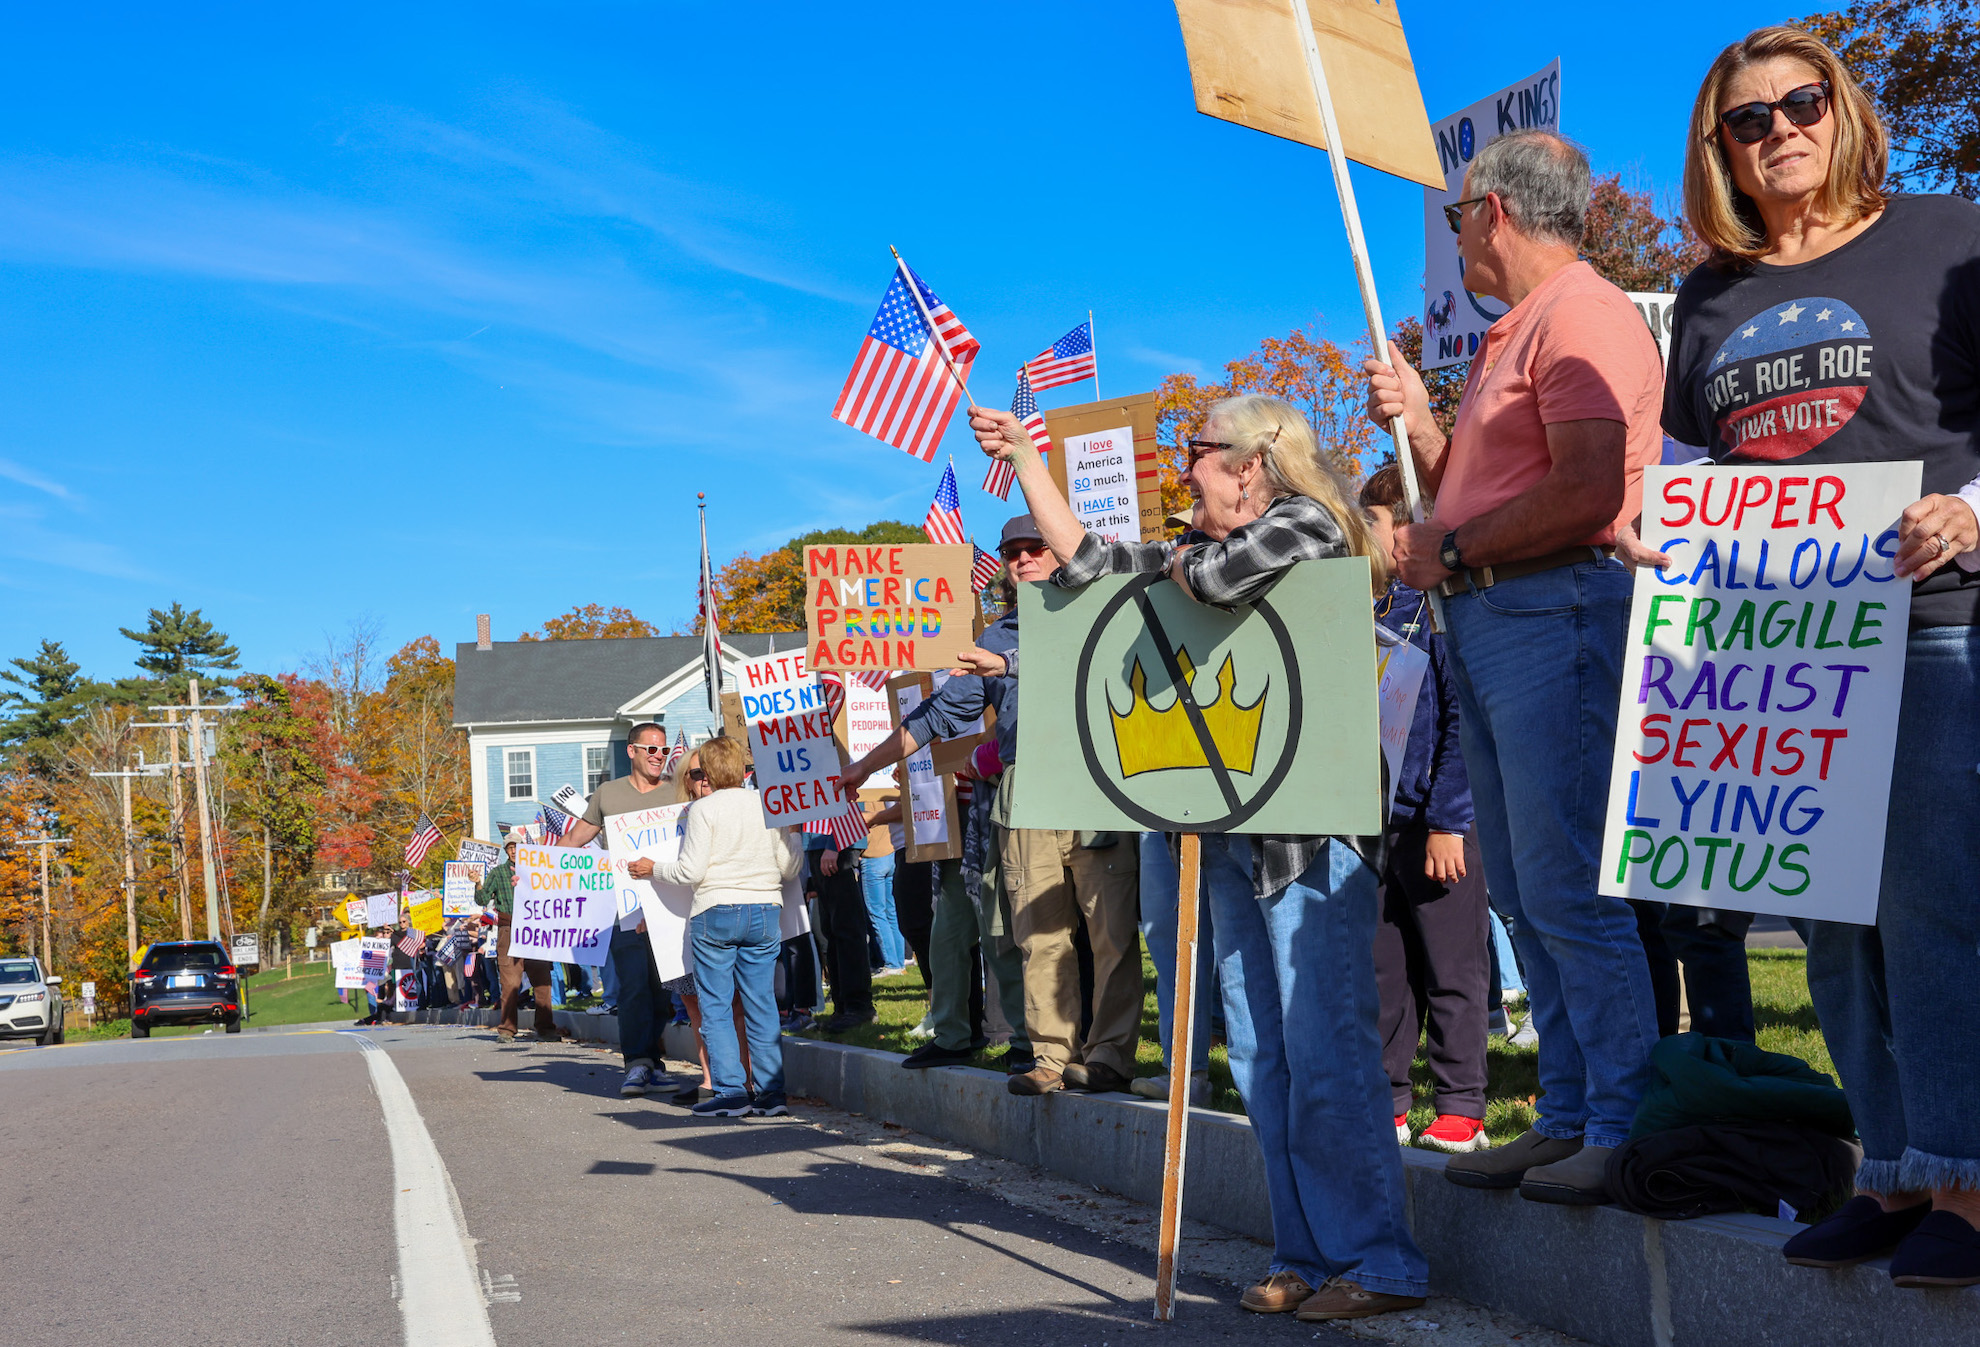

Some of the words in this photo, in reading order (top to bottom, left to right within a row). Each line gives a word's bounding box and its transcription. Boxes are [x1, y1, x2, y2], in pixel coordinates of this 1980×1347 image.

[1438, 117, 1475, 175] NO
[1497, 70, 1557, 135] KINGS
[1438, 332, 1463, 359] NO
[1704, 368, 1750, 412] ROE,
[1755, 353, 1811, 395] ROE,
[1819, 344, 1873, 380] ROE
[1729, 409, 1777, 447] YOUR
[1781, 398, 1840, 433] VOTE
[1083, 442, 1087, 452] I
[1089, 440, 1113, 451] love
[1077, 456, 1123, 471] America
[1074, 478, 1091, 490] SO
[1094, 472, 1128, 486] much,
[1077, 502, 1081, 512] I
[1084, 497, 1114, 511] HAVE
[1118, 497, 1129, 506] to
[1660, 475, 1846, 531] SUPER
[1096, 517, 1106, 528] at
[1109, 514, 1130, 525] this
[808, 547, 904, 577] MAKE
[1655, 529, 1898, 591] CALLOUS
[815, 577, 954, 607] AMERICA
[817, 607, 942, 639] PROUD
[1643, 594, 1887, 652] FRAGILE
[812, 639, 915, 668] AGAIN
[745, 655, 808, 688] HATE
[1637, 655, 1870, 718] RACIST
[851, 701, 890, 711] GRIFTE
[757, 711, 832, 746] MAKE
[777, 748, 811, 773] US
[1632, 713, 1848, 780] SEXIST
[908, 759, 932, 773] VOICES
[555, 786, 576, 804] ING
[763, 775, 841, 816] GREAT
[1625, 770, 1825, 836] LYING
[614, 815, 628, 832] IT
[637, 807, 676, 826] TAKES
[913, 809, 940, 822] FUTURE
[518, 848, 555, 869] REAL
[560, 853, 593, 870] GOOD
[1616, 829, 1811, 896] POTUS
[579, 872, 614, 891] NEED
[523, 896, 587, 920] SECRET
[362, 941, 370, 949] NO
[372, 942, 389, 950] KINGS
[515, 926, 600, 949] IDENTITIES
